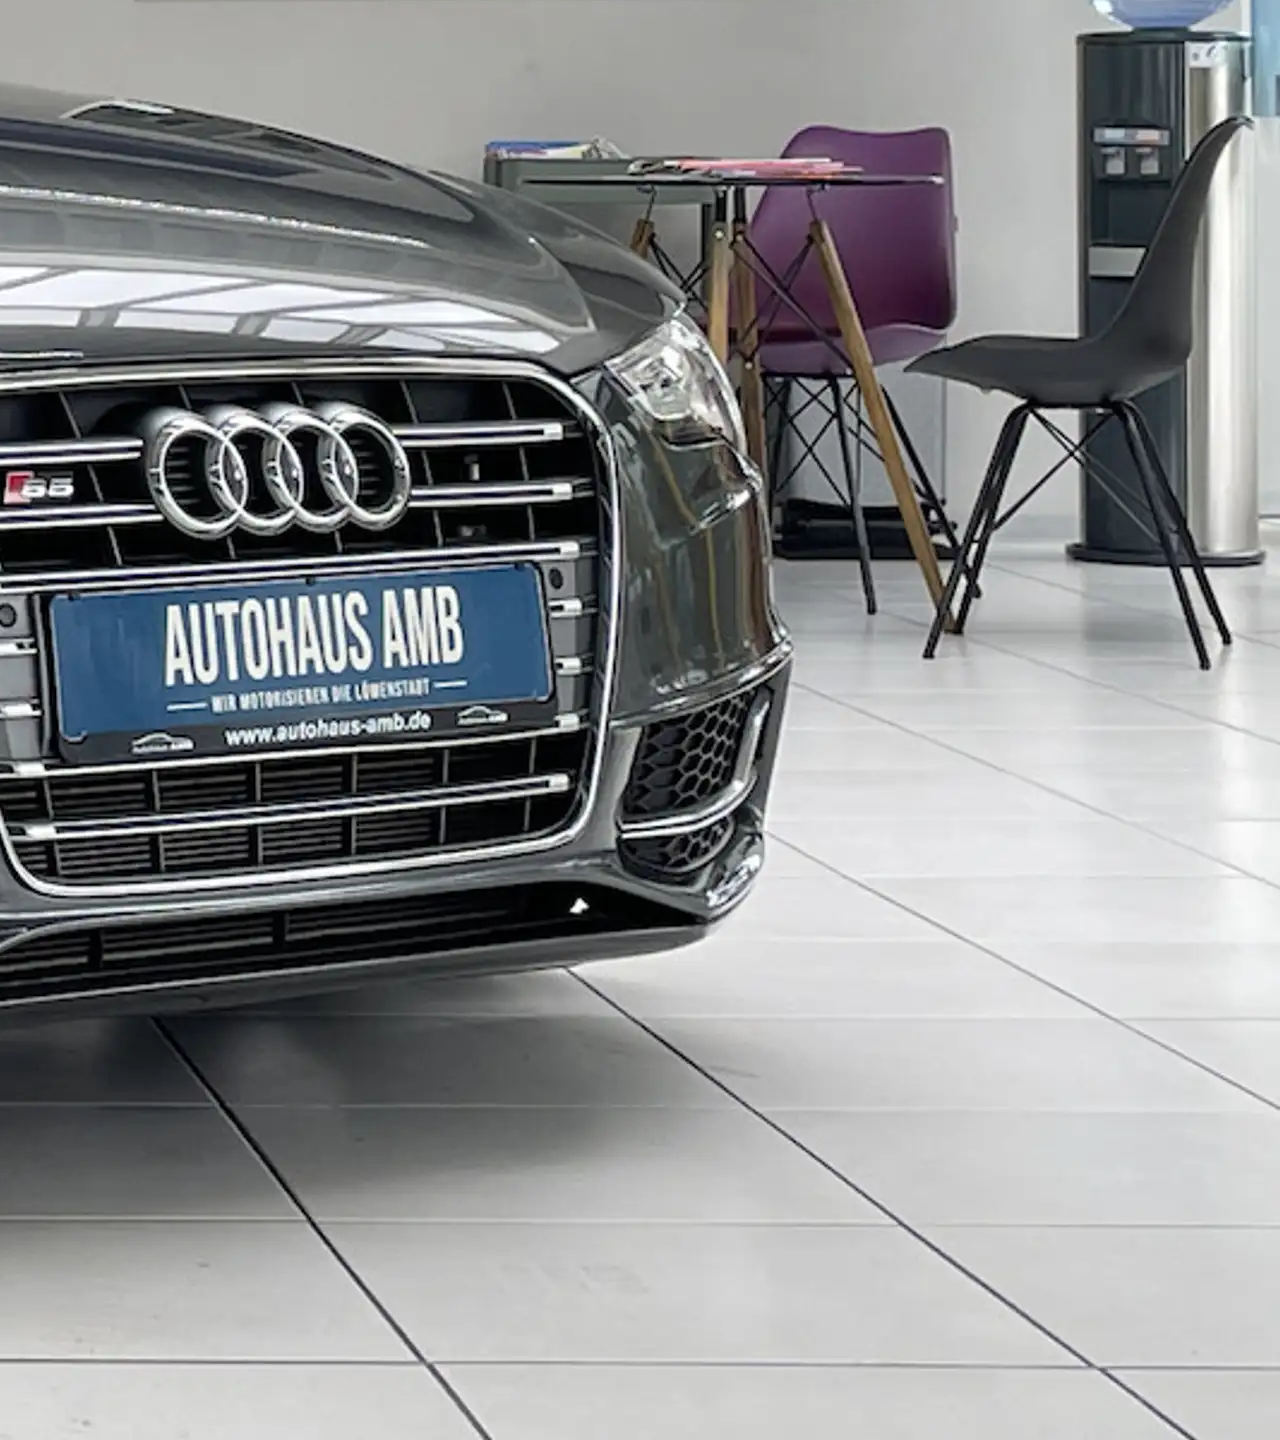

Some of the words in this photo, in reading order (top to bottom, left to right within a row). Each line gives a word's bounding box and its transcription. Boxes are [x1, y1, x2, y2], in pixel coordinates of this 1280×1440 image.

[165, 591, 374, 686] AUTOHAUS
[382, 585, 464, 669] AMB
[211, 693, 238, 713] WIR
[224, 710, 432, 747] www.autohaus-amb.de
